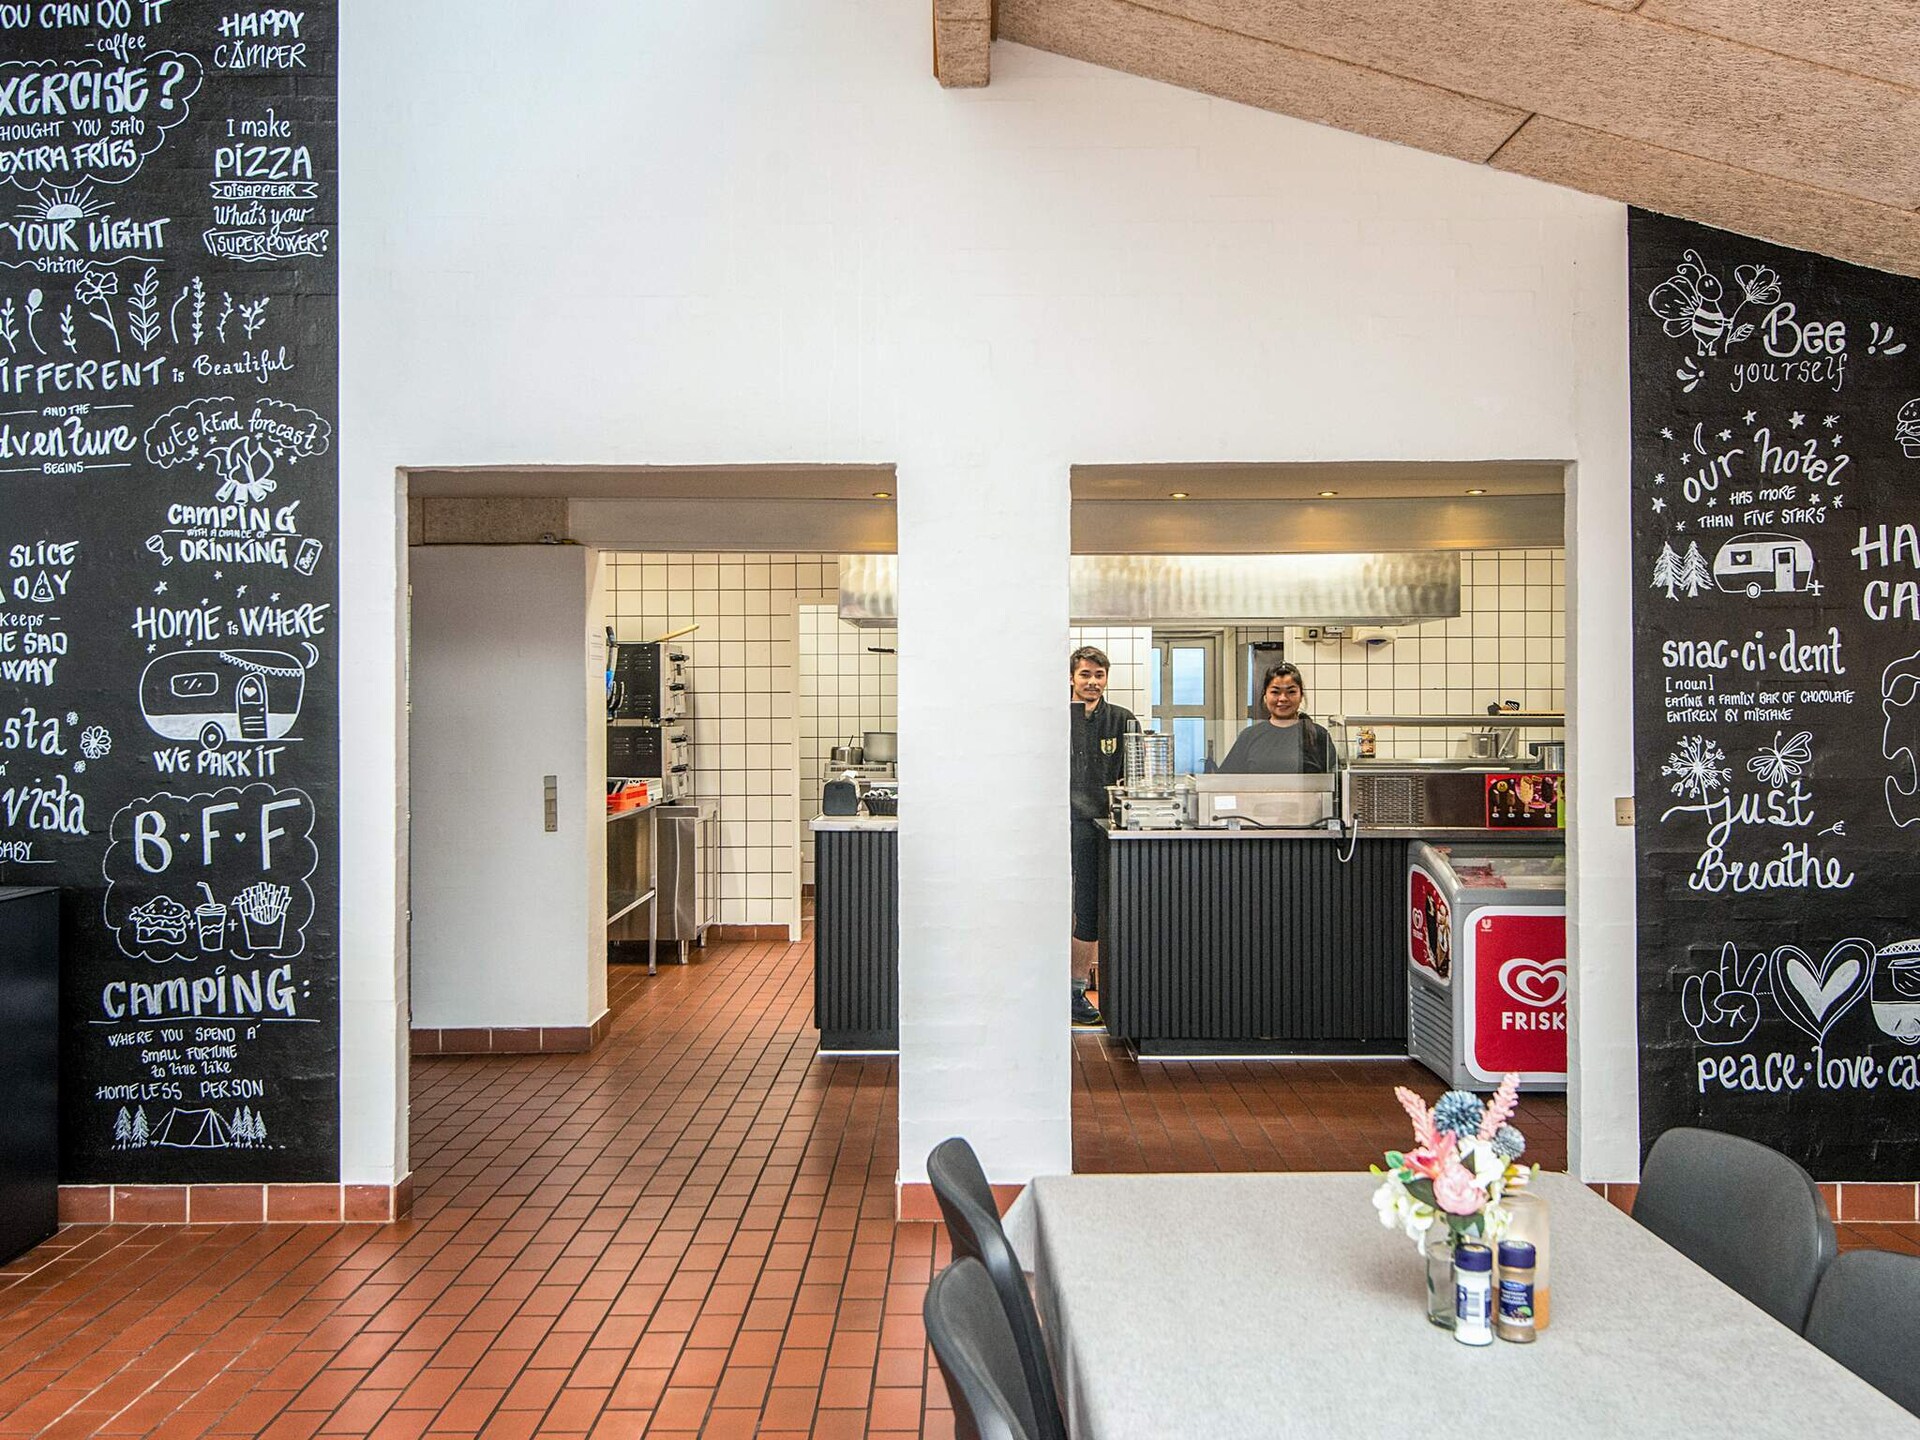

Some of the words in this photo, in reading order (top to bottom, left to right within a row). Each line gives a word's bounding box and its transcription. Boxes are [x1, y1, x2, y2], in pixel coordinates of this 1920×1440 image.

[0, 3, 30, 29] OU
[39, 3, 90, 28] CAN
[97, 0, 131, 28] DO
[218, 9, 304, 37] HAPPY
[72, 118, 101, 136] YOU
[110, 115, 145, 136] SAID
[227, 118, 235, 137] I
[241, 108, 291, 138] make
[0, 145, 69, 174] EXTRA
[71, 136, 137, 169] FRIES
[214, 143, 312, 179] PIZZA
[223, 183, 296, 197] DISAPPEAR
[213, 200, 266, 226] What's
[270, 207, 315, 237] your
[9, 218, 79, 251] YOUR
[89, 215, 171, 252] LIGHT
[37, 256, 84, 274] shine
[1761, 302, 1846, 358] Bee
[172, 368, 185, 382] is
[193, 346, 294, 384] Beautiful
[1730, 353, 1848, 393] yourself
[43, 405, 67, 416] AND
[68, 403, 90, 414] THE
[248, 408, 318, 450] forecast
[43, 461, 84, 474] BEGINS
[1729, 491, 1753, 505] HAS
[1759, 485, 1797, 501] MORE
[167, 500, 301, 534] CAMPING
[1697, 515, 1734, 528] THAN
[1743, 510, 1774, 526] FIVE
[1781, 506, 1827, 524] STARS
[186, 527, 208, 537] WITH
[210, 529, 217, 537] A
[218, 529, 252, 539] CHANCE
[256, 531, 267, 539] OF
[9, 540, 80, 568] SLICE
[180, 537, 289, 569] DRINKING
[131, 606, 222, 641] HOME
[227, 621, 239, 636] is
[239, 603, 331, 639] WHERE
[23, 632, 68, 655] SAD
[1665, 694, 1703, 707] EATING
[1708, 696, 1715, 706] A
[1718, 691, 1755, 706] FAMILY
[1759, 692, 1780, 705] BAR
[1782, 690, 1796, 704] OF
[1800, 690, 1855, 704] CHOCOLATE
[1667, 708, 1718, 723] ENTIRELY
[1725, 709, 1739, 721] BY
[1744, 707, 1794, 721] MISTAKE
[153, 747, 190, 773] WE
[196, 748, 250, 777] PARK
[255, 745, 286, 777] IT
[2, 774, 90, 836] vista
[1660, 779, 1815, 848] just
[1688, 842, 1855, 893] Breathe
[107, 1030, 153, 1047] WHERE
[160, 1028, 184, 1042] YOU
[195, 1026, 236, 1042] SPEND
[141, 1049, 181, 1064] SMALL
[185, 1044, 238, 1060] FORTUNE
[150, 1064, 166, 1078] to
[168, 1061, 198, 1076] live
[95, 1082, 183, 1100] HOMELESS
[200, 1079, 264, 1100] PERSON
